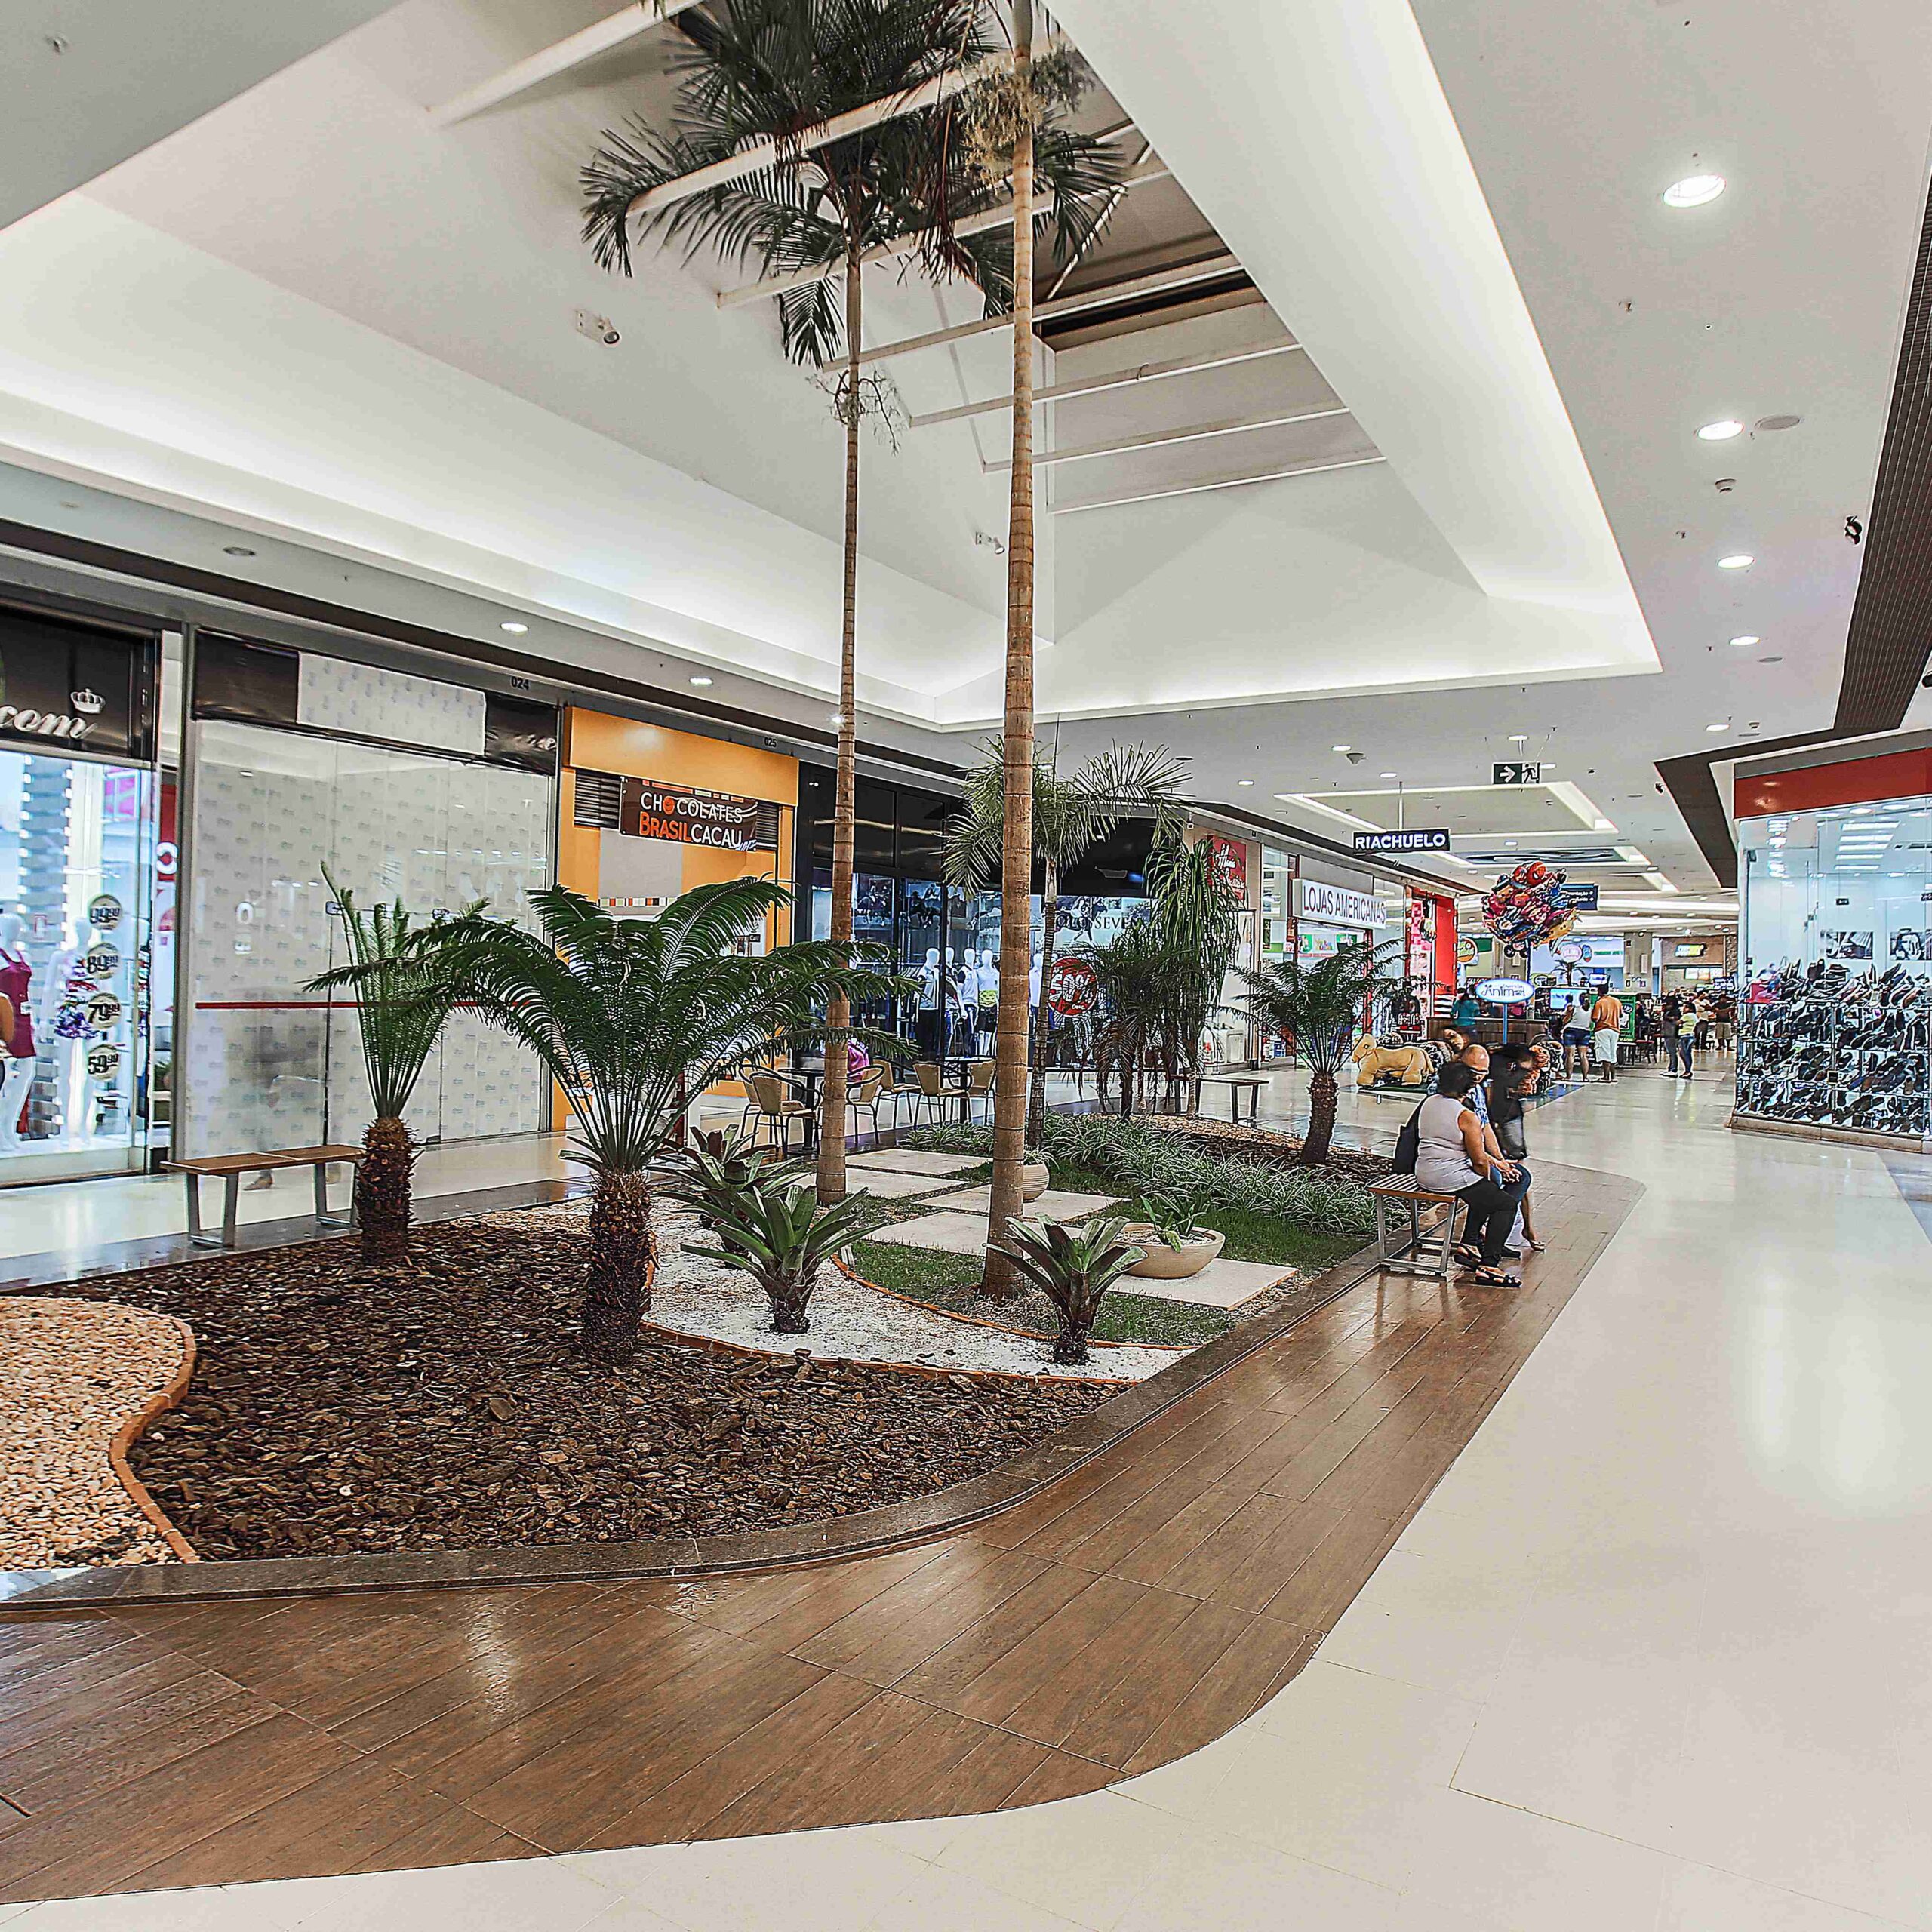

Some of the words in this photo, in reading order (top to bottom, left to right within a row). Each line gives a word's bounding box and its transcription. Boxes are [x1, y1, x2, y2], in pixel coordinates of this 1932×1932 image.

[511, 676, 530, 691] 024
[764, 737, 777, 748] 025
[641, 792, 743, 824] CHOCOLATES
[1355, 833, 1446, 850] RIACHUELO
[1303, 885, 1334, 915] LOJAS
[1334, 892, 1386, 924] AMERICANAS
[1057, 915, 1090, 929] OLO
